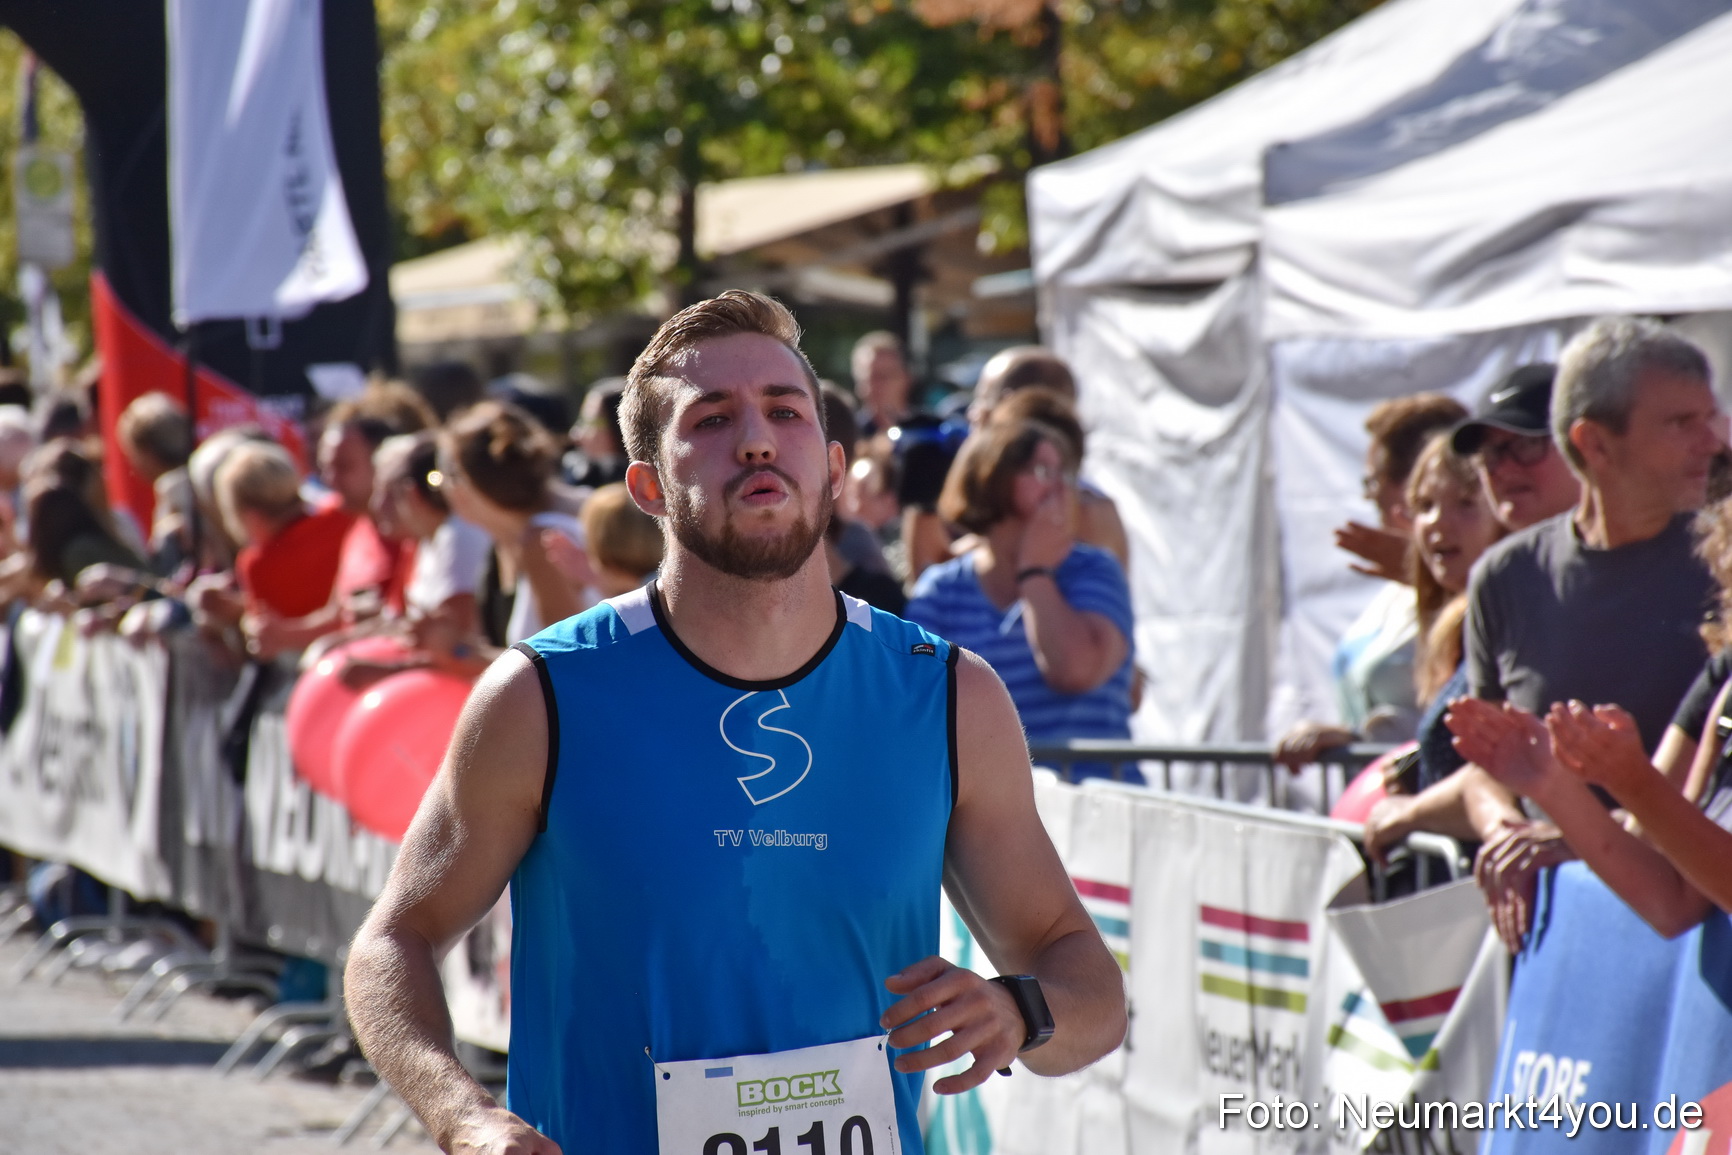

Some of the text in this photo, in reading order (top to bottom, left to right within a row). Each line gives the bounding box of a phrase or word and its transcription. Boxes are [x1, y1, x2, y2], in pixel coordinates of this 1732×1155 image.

[714, 829, 828, 851] TV Velburg
[737, 1069, 843, 1108] BOCK
[738, 1096, 845, 1118] inspired by smart concepts
